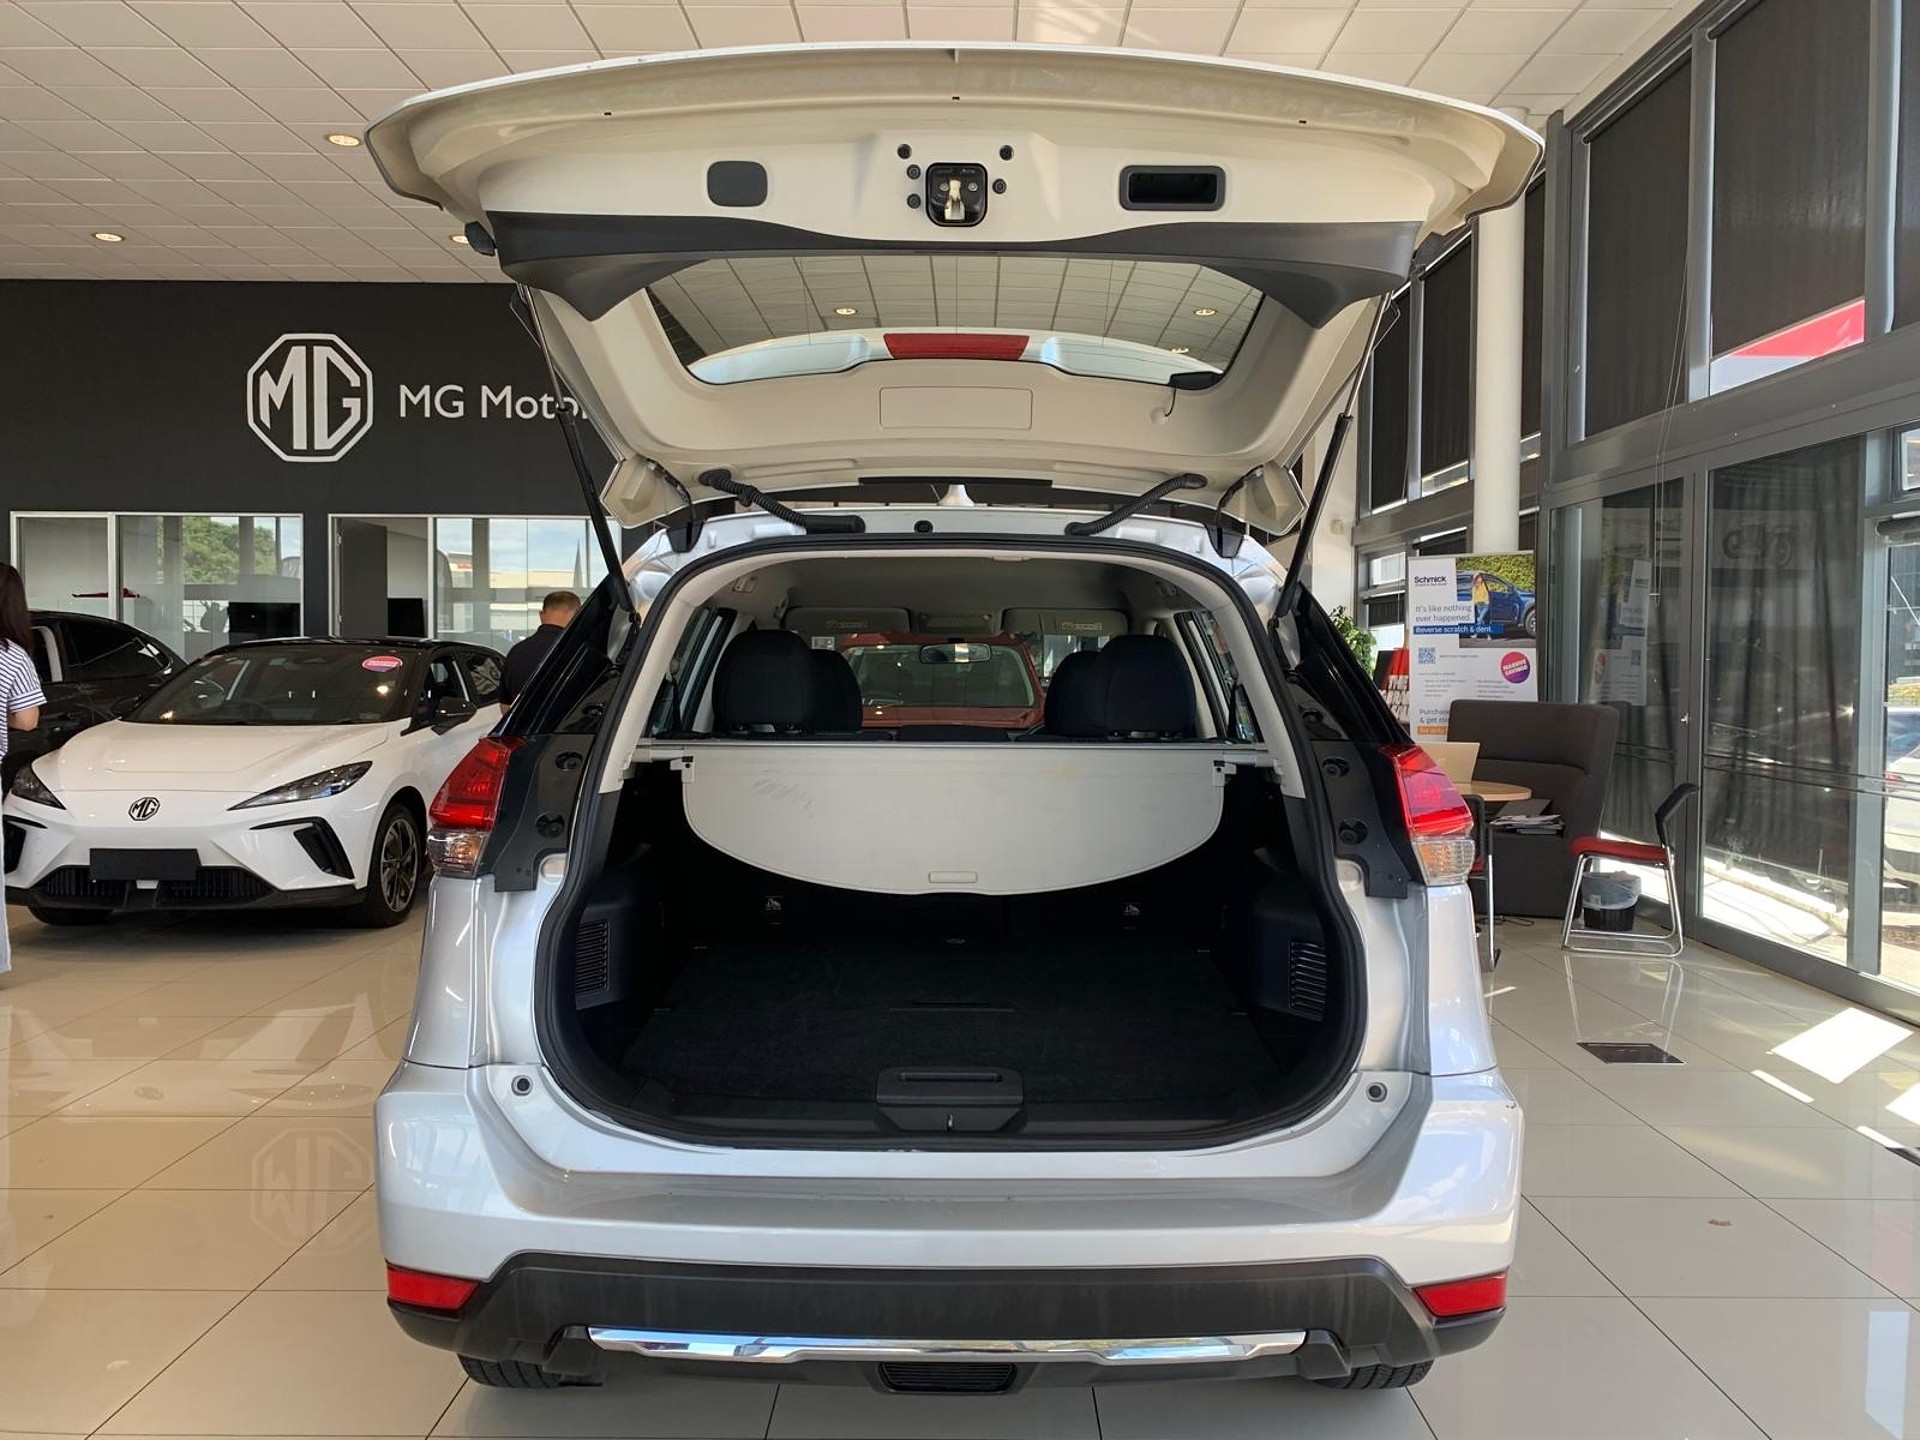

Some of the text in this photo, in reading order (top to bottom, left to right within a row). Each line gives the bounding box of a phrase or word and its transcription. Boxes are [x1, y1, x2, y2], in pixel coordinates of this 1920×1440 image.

[259, 346, 361, 450] MG
[400, 384, 588, 419] MG Moto
[1414, 575, 1447, 584] Schmick
[1443, 604, 1472, 614] nothing
[1444, 625, 1468, 633] scratch
[132, 800, 157, 818] MG
